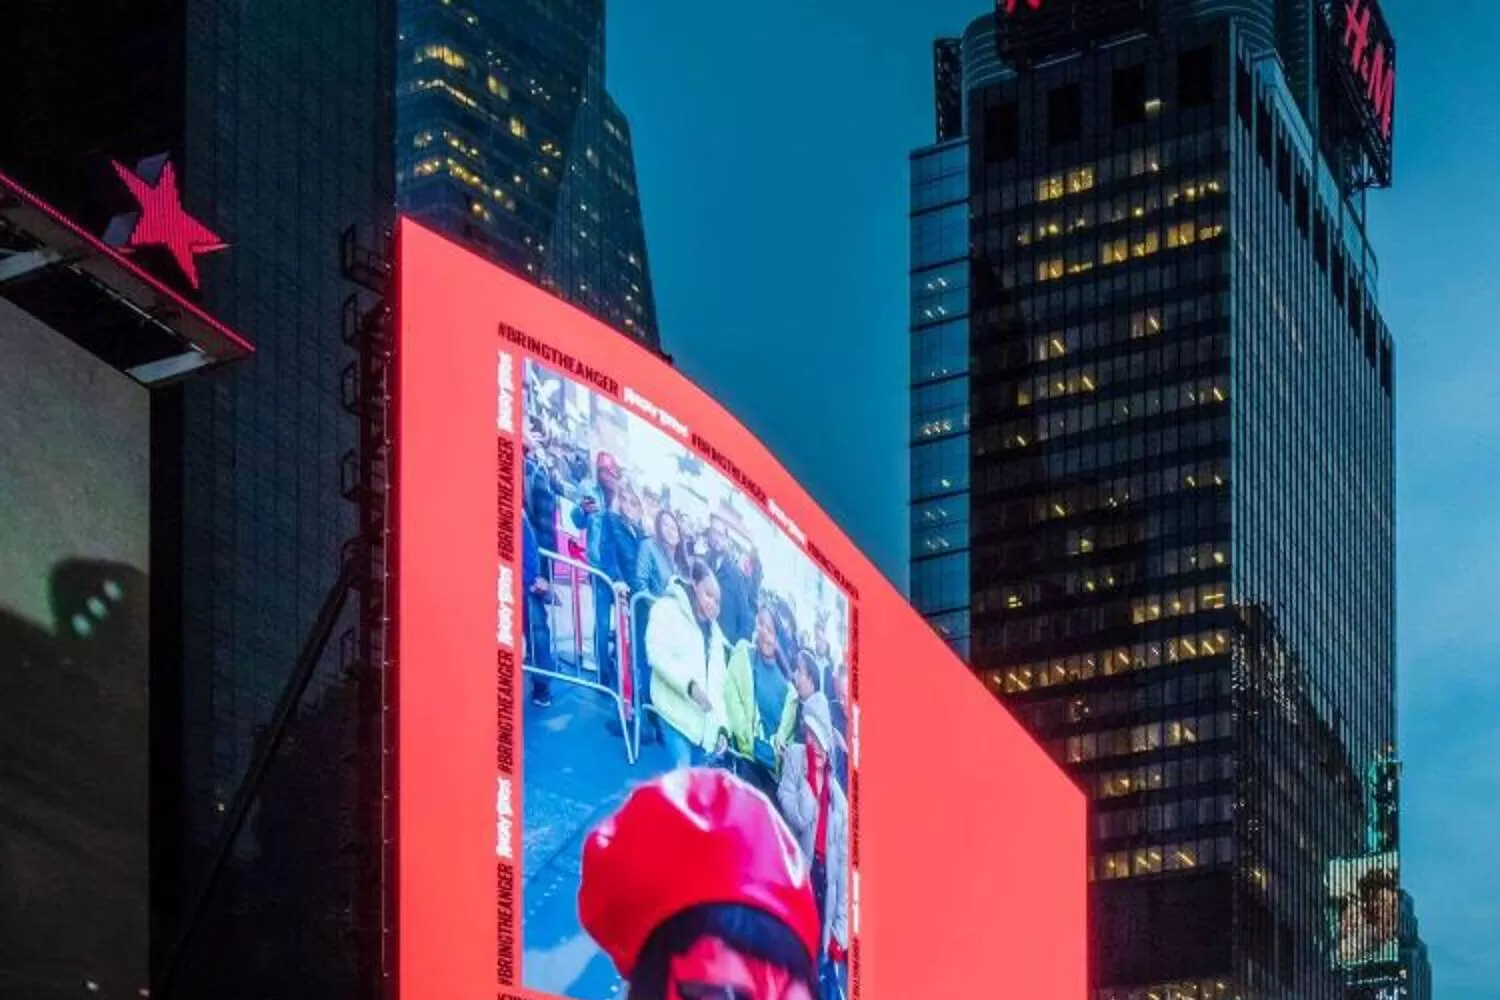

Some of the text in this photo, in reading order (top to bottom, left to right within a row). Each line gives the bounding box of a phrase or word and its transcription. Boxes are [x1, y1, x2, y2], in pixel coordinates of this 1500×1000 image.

[498, 322, 618, 396] #BRINGTHEANGER
[497, 436, 514, 562] #BRINGTHEANGER
[497, 650, 514, 775] #BRINGTHEANGER
[497, 863, 514, 986] #BRINGTHEANGER
